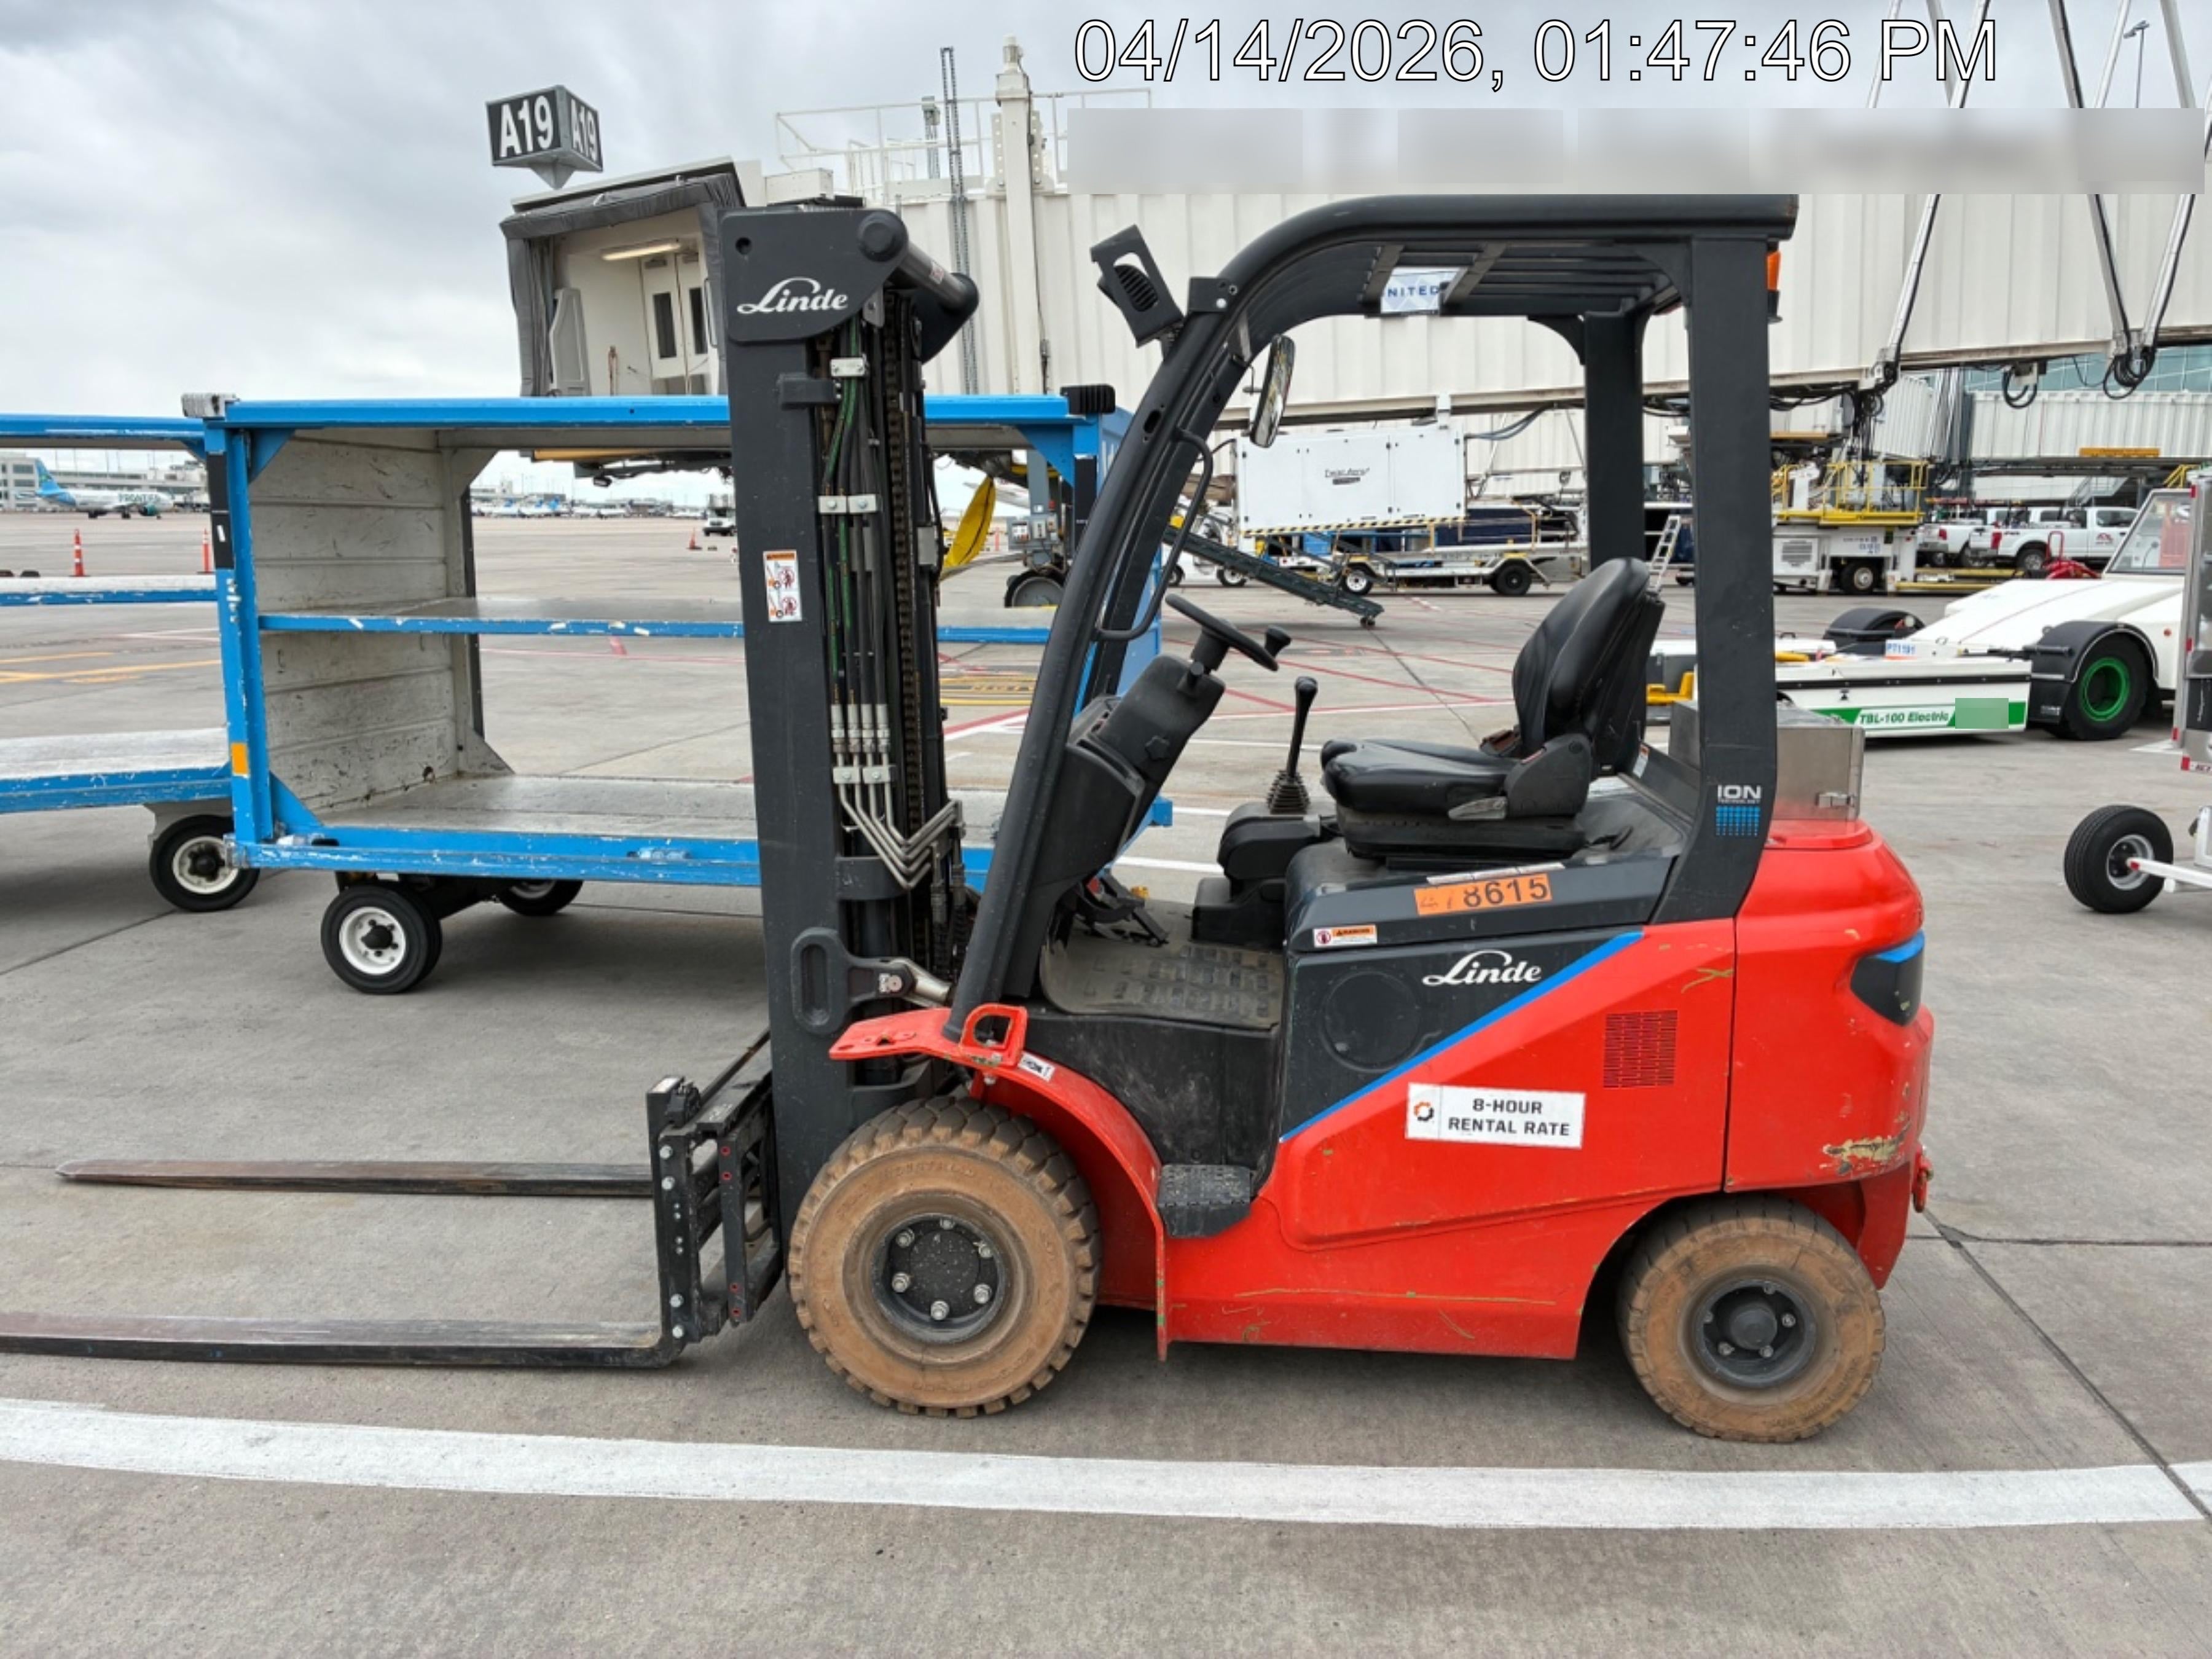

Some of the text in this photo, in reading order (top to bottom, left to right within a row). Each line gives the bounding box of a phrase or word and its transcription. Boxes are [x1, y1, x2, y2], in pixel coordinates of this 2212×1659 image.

[500, 95, 553, 158] A19
[570, 98, 598, 162] A19
[737, 276, 849, 314] Linde
[1387, 285, 1440, 297] NITED
[1860, 710, 1949, 724] TBL-100 Electric
[1717, 785, 1761, 799] ION
[1422, 949, 1542, 986] Linde
[1472, 1098, 1543, 1115] 8-HOUR
[1448, 1116, 1571, 1136] RENTAL RATE
